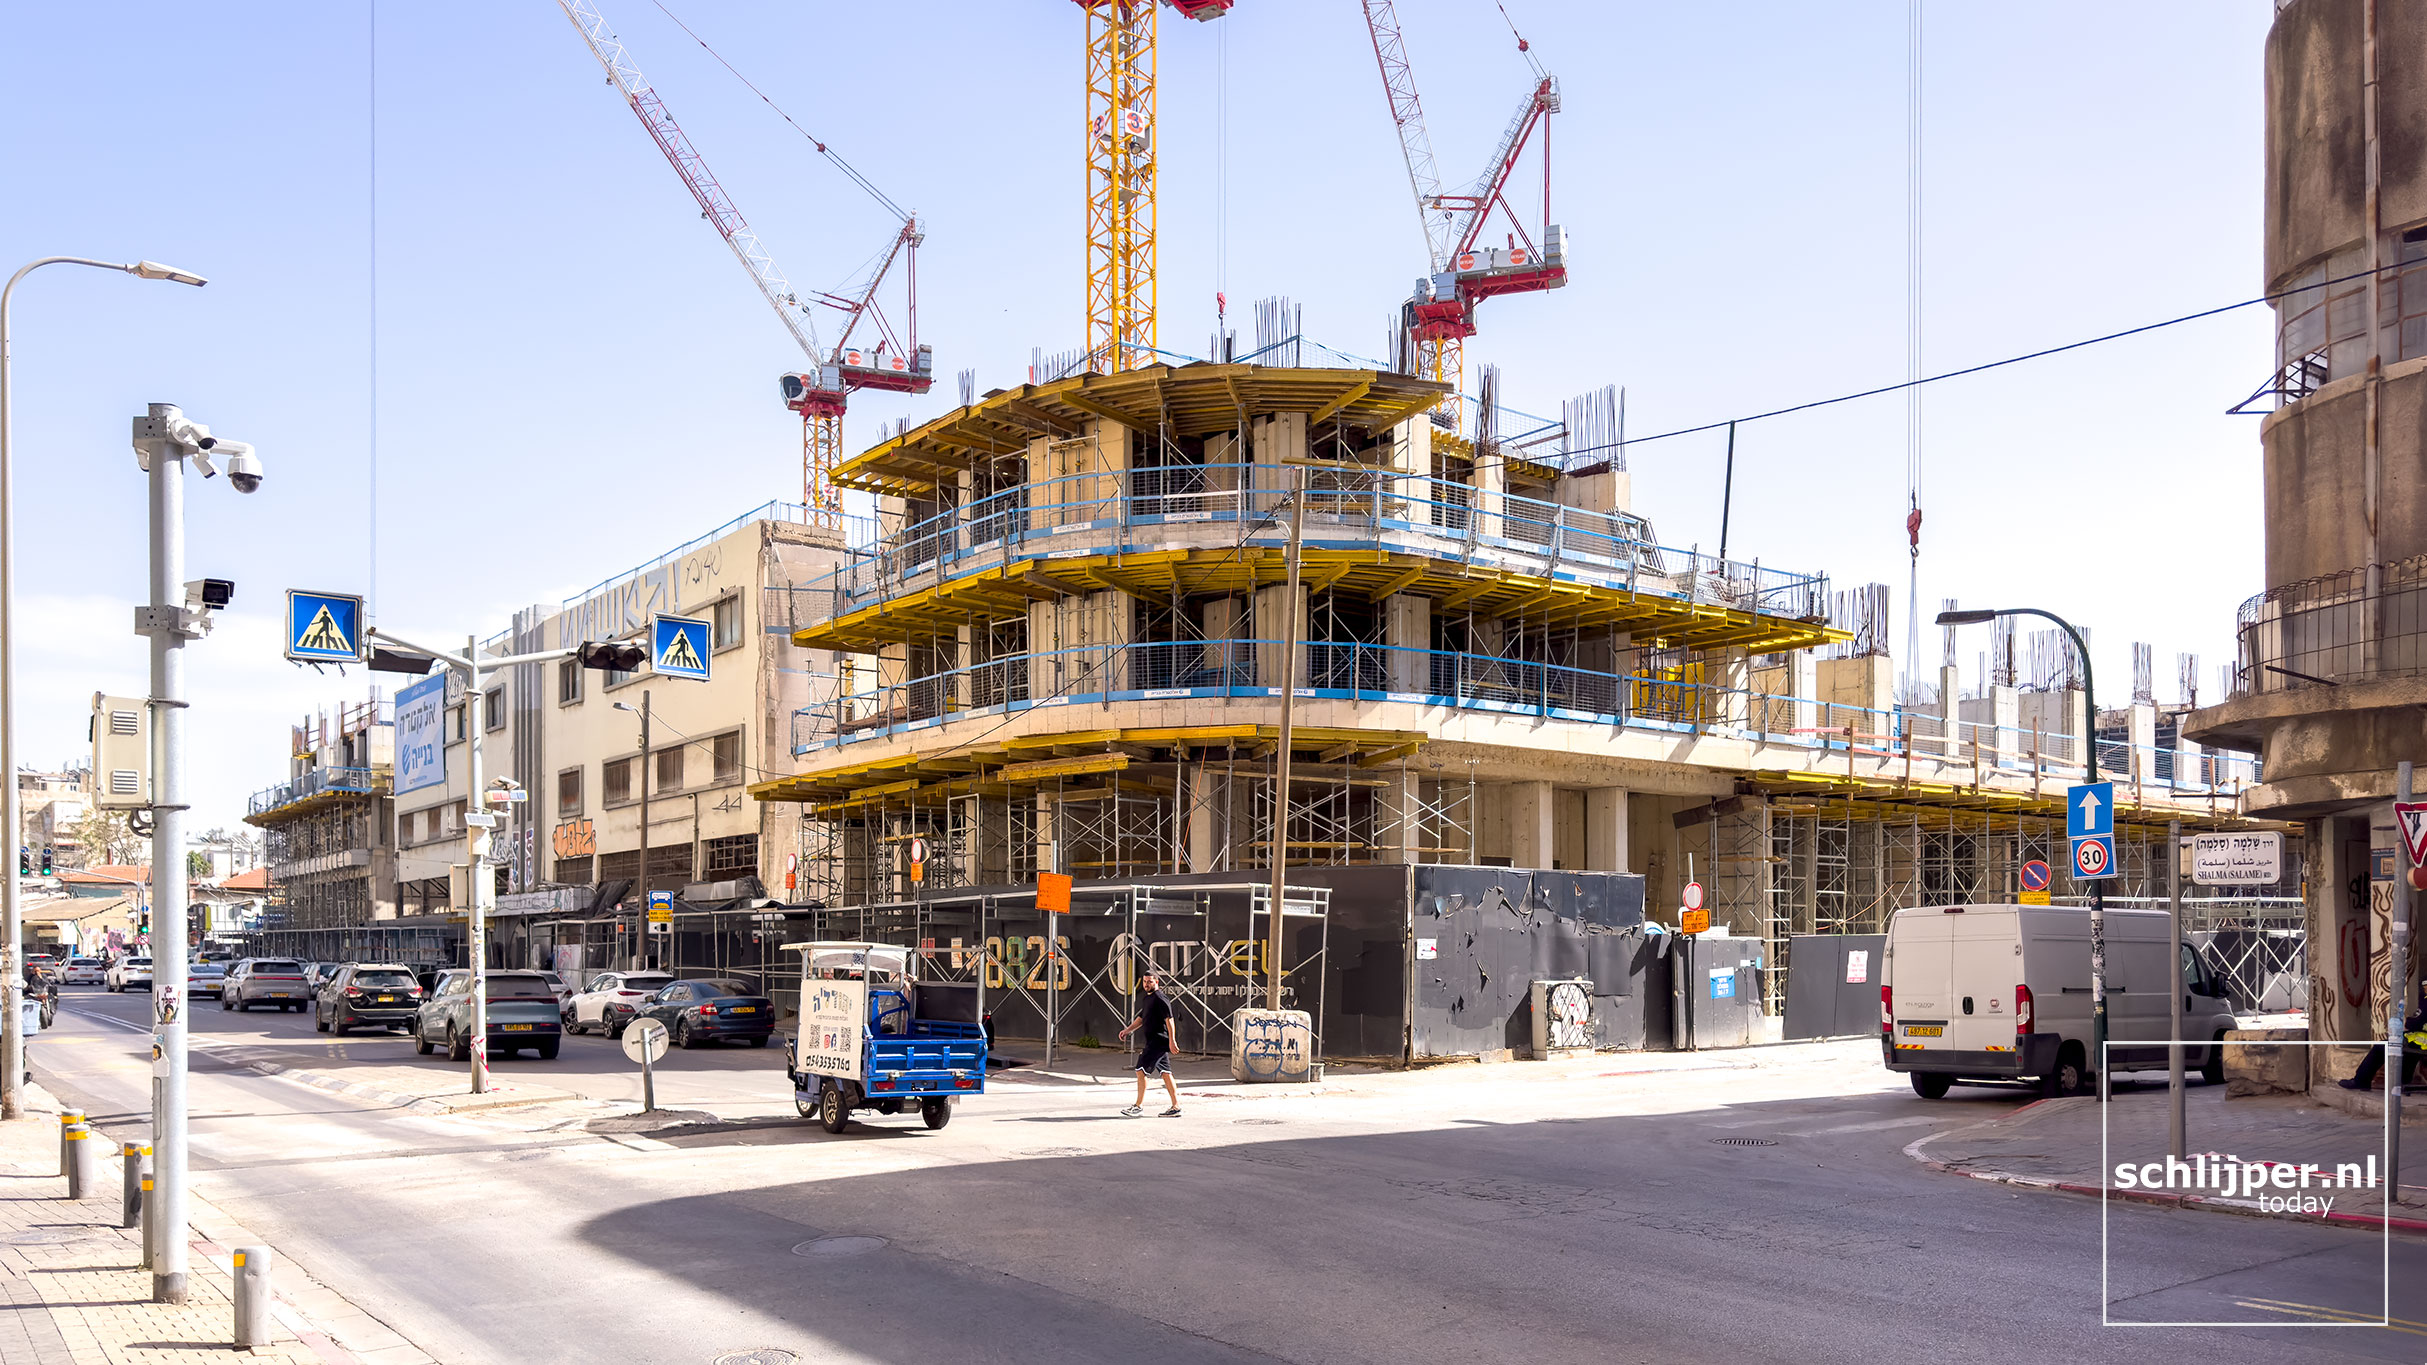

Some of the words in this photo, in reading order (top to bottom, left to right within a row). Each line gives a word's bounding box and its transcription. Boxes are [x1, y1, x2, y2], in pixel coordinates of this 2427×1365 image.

[412, 743, 434, 770] בנייה
[2082, 849, 2102, 865] 30
[2197, 870, 2227, 880] SHALMA
[2228, 869, 2263, 880] (SALAME)
[805, 1054, 850, 1072] 0543535760
